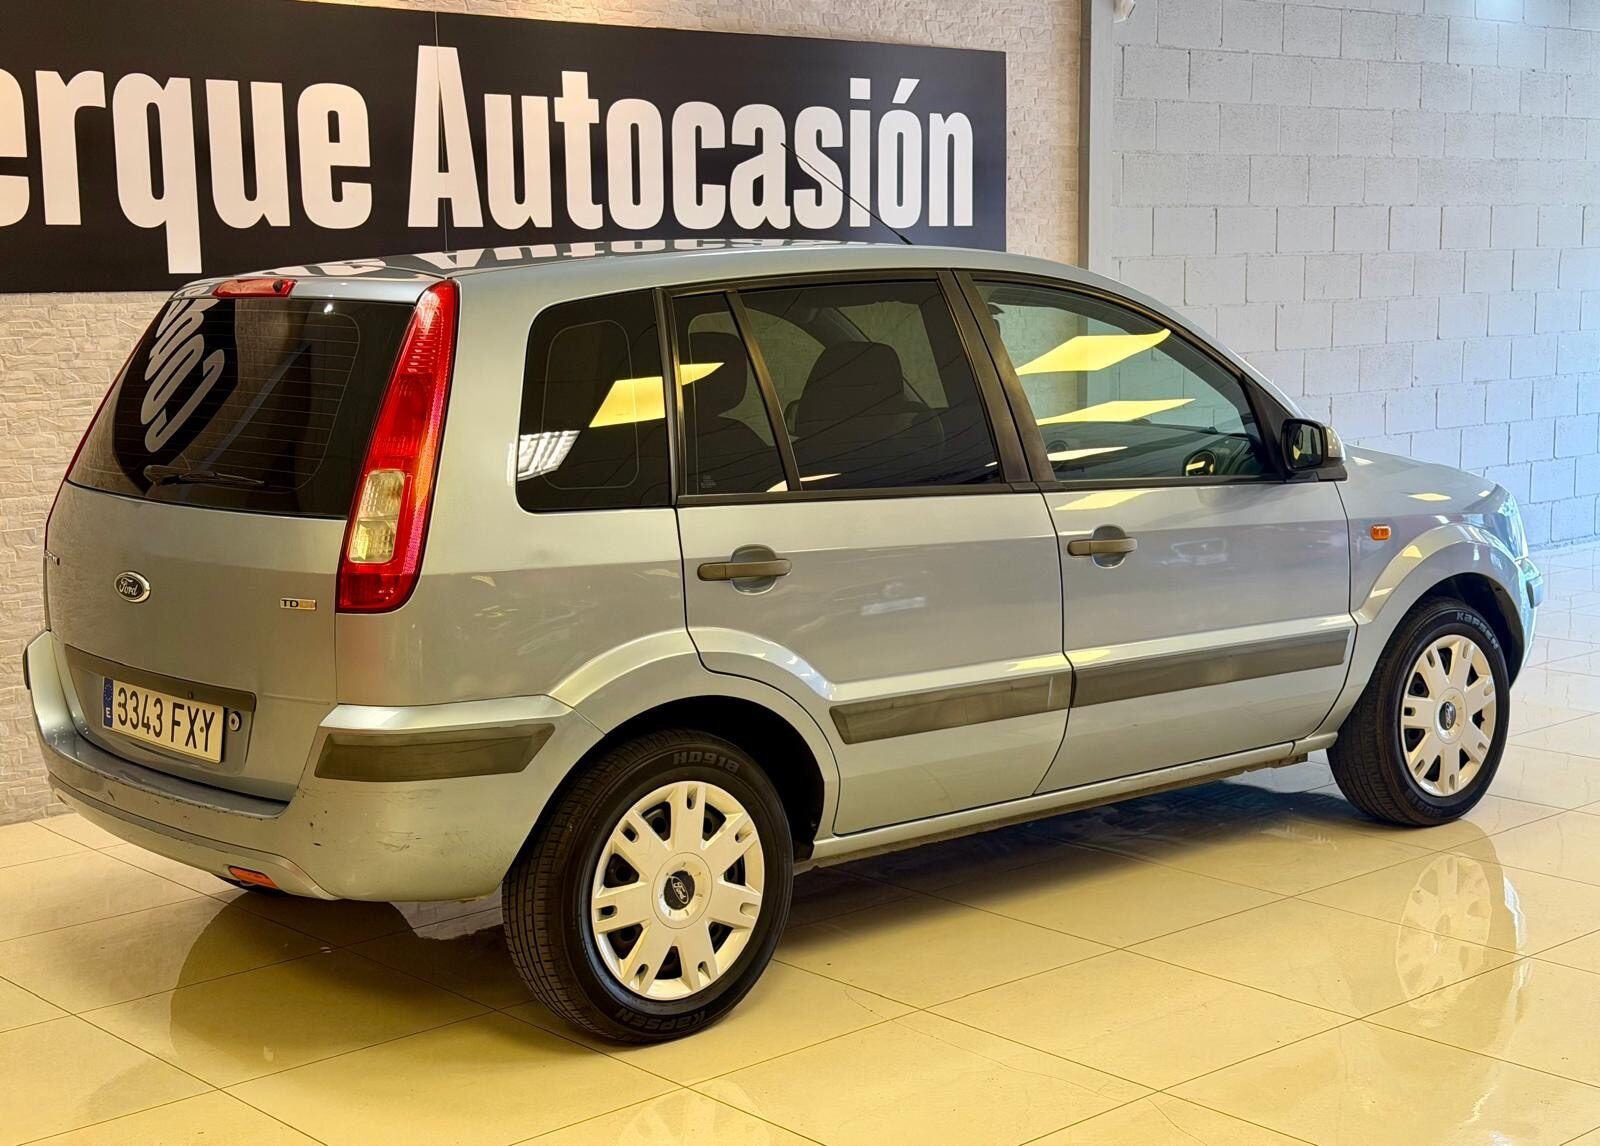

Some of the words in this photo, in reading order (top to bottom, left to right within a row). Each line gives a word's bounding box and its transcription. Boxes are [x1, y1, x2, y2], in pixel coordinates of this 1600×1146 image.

[407, 45, 973, 230] Autocasión
[105, 706, 112, 719] E
[117, 687, 164, 738] 3343
[170, 702, 216, 752] FXY
[672, 751, 740, 773] HD918
